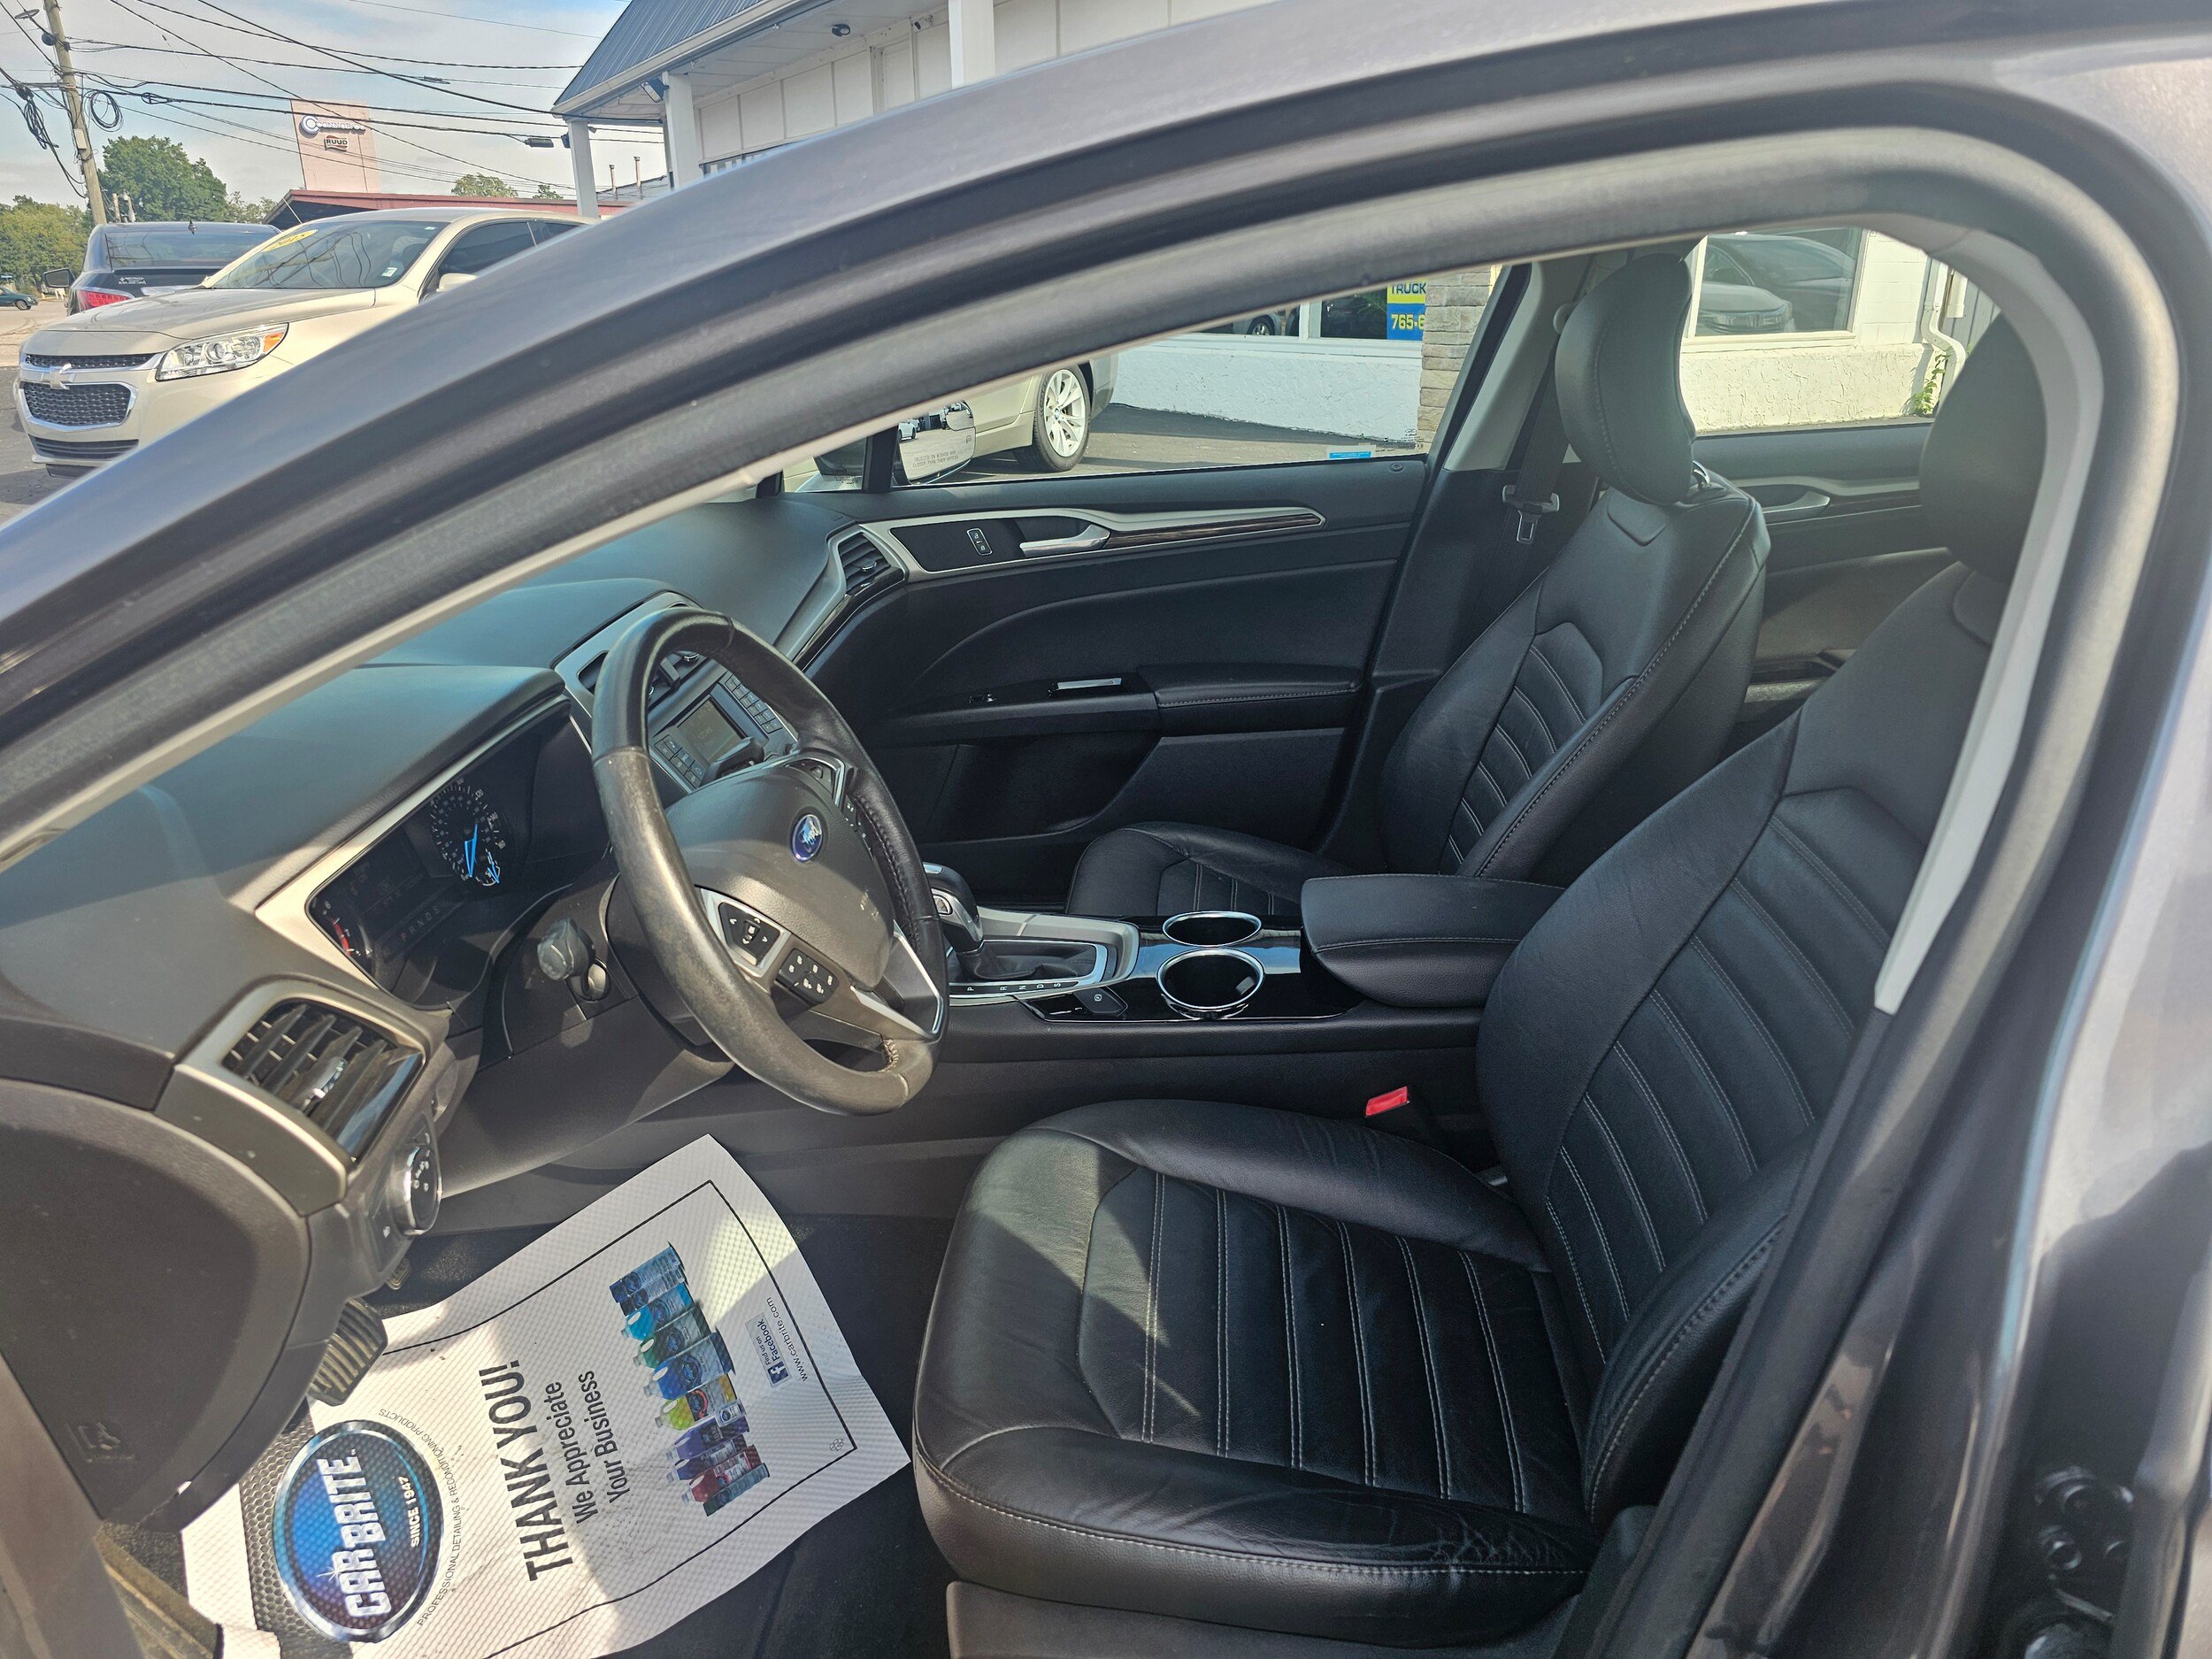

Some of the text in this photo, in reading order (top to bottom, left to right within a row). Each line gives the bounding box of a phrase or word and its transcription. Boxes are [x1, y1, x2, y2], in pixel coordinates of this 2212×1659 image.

[757, 1318, 780, 1362] Facebook
[762, 1353, 772, 1366] Find
[766, 1297, 808, 1381] www.carbrite.com
[378, 1409, 423, 1437] PRODUCTS
[544, 1381, 599, 1524] We Appreciate
[578, 1371, 631, 1503] Your Business
[420, 1433, 458, 1496] RECONDITIONING
[479, 1359, 573, 1582] THANK YOU!
[317, 1456, 387, 1549] BRITE
[398, 1476, 421, 1548] SINCE 1947
[451, 1508, 463, 1552] DETAILING
[417, 1550, 460, 1626] PROFESSIONAL
